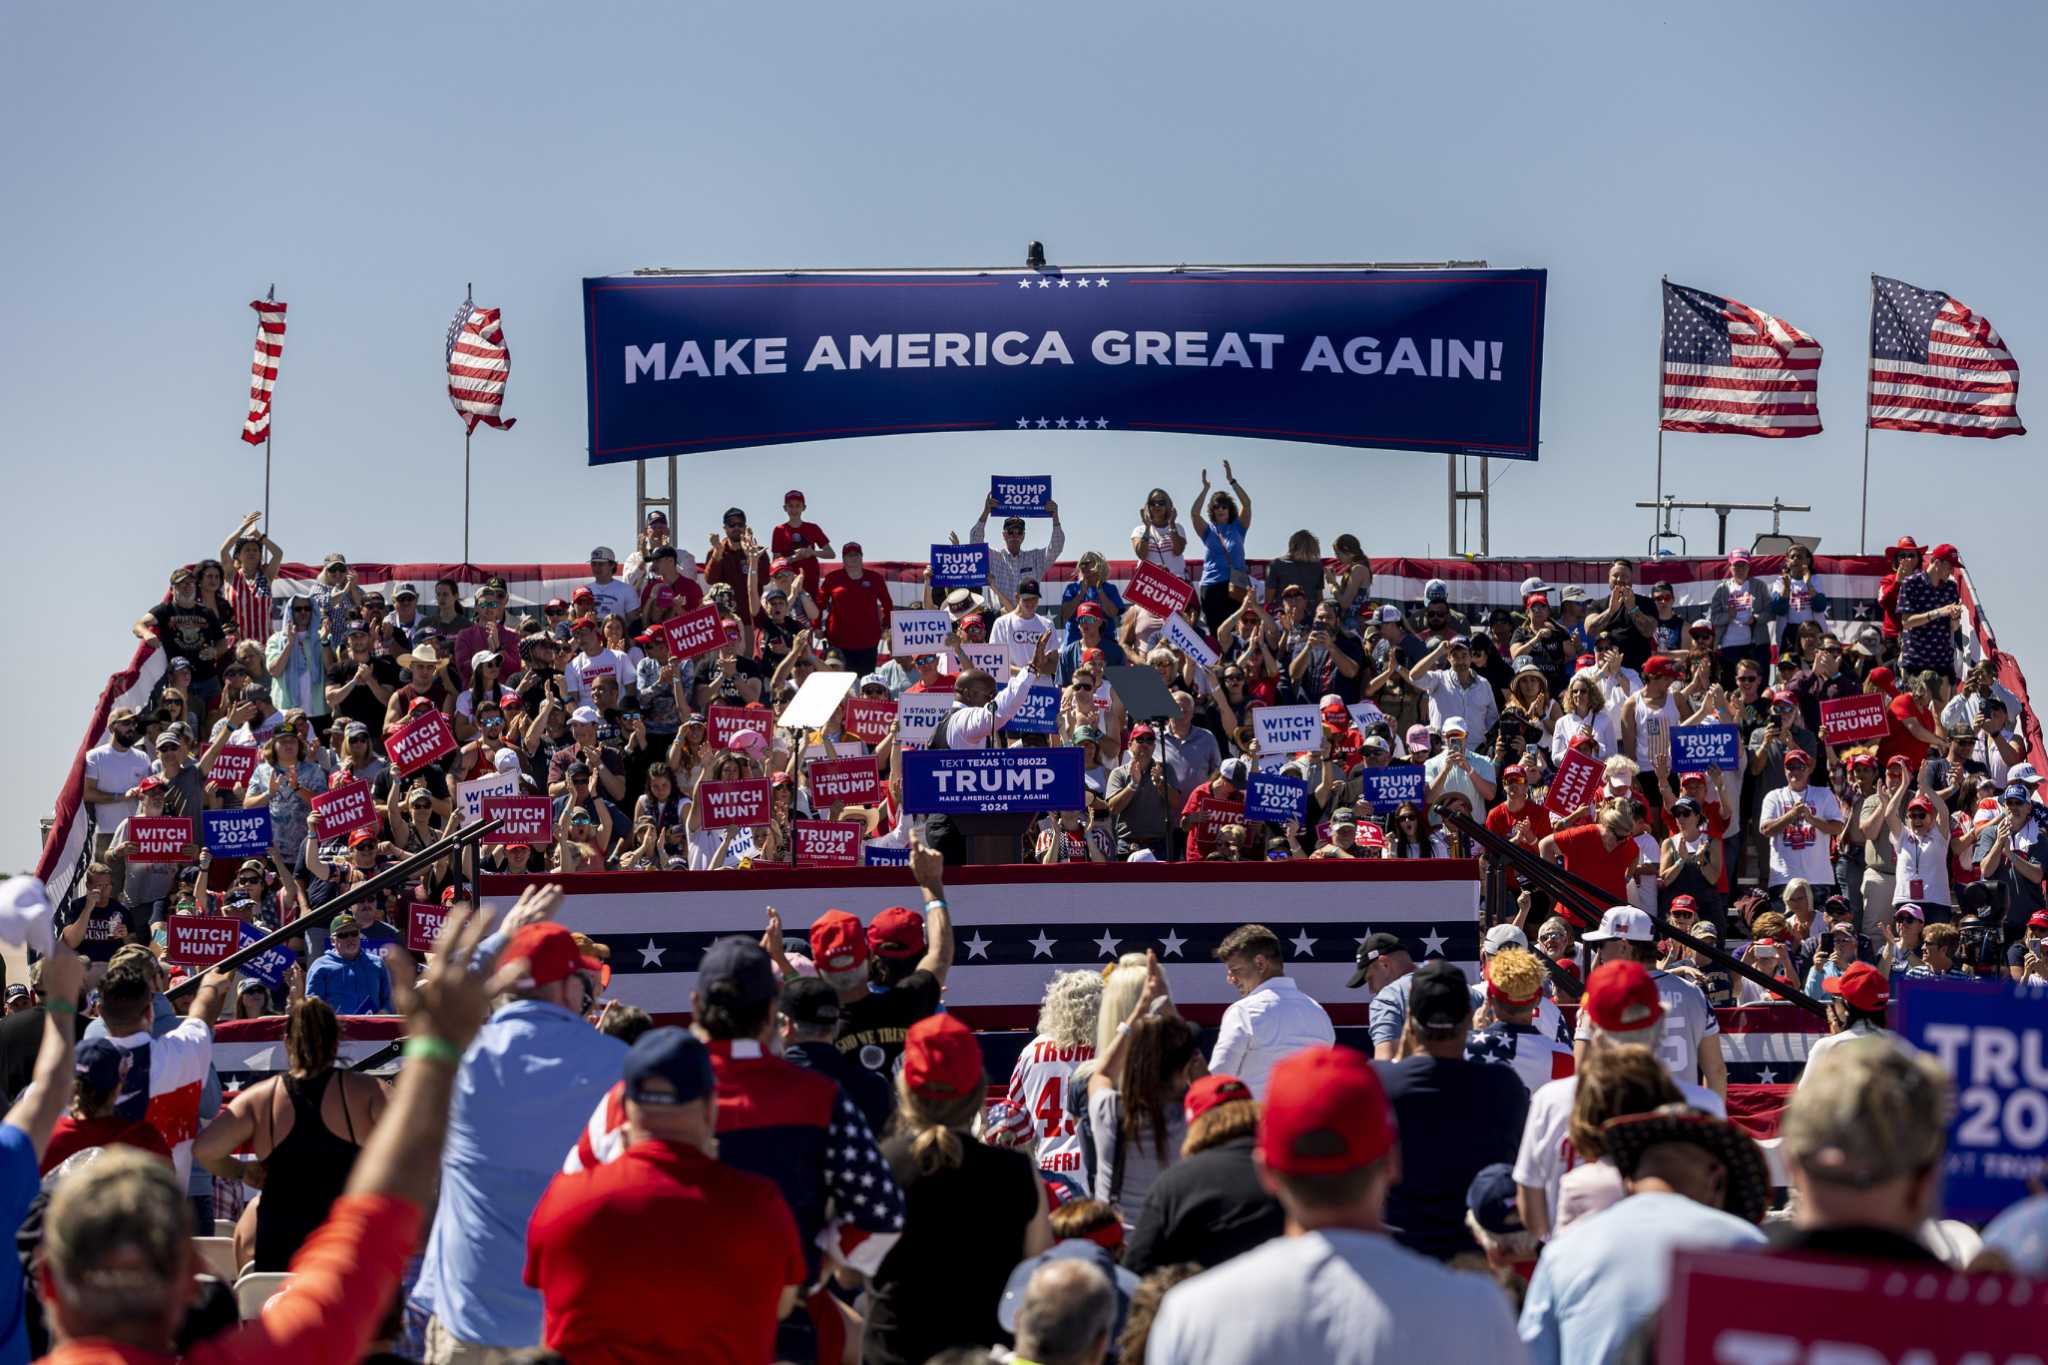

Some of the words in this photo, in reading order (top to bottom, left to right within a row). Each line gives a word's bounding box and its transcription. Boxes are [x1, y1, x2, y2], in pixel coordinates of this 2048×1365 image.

[625, 337, 787, 384] MAKE
[803, 330, 1074, 372] AMERICA
[1091, 330, 1285, 369] GREAT
[1300, 335, 1503, 381] AGAIN!
[997, 484, 1047, 495] TRUMP
[1004, 495, 1040, 505] 2024
[935, 552, 983, 564] TRUMP
[942, 563, 977, 574] 2024
[1134, 578, 1184, 612] TRUMP
[1144, 575, 1169, 594] STAND
[1169, 586, 1186, 603] WITH
[670, 616, 716, 640] WITCH
[899, 621, 946, 633] WITCH
[677, 629, 715, 651] HUNT
[904, 634, 944, 645] HUNT
[1171, 624, 1207, 666] WITCH
[1024, 695, 1055, 707] UMP
[853, 709, 897, 722] WITC
[1016, 706, 1045, 719] 024
[1830, 709, 1857, 720] STAND
[1859, 706, 1881, 715] WITH
[715, 716, 767, 732] WITCH
[903, 715, 941, 727] TRU
[1262, 717, 1315, 731] WITCH
[1826, 714, 1883, 733] TRUMP
[856, 723, 889, 736] HUN
[1268, 730, 1312, 743] HUNT
[393, 720, 441, 754] WITCH
[1677, 733, 1732, 747] TRUMP
[401, 735, 442, 764] HUNT
[1686, 745, 1725, 758] 2024
[940, 759, 964, 768] TEXT
[967, 758, 999, 767] TEXAS
[1001, 758, 1015, 766] TO
[1017, 757, 1048, 766] 88022
[208, 770, 245, 780] HUNT
[820, 772, 849, 782] STAND
[850, 771, 874, 780] WITH
[932, 768, 1056, 793] TRUMP
[1370, 774, 1421, 787] TRUMP
[816, 779, 875, 796] TRUMP
[1556, 762, 1580, 804] HUNT
[1565, 765, 1594, 813] WITCH
[465, 783, 514, 802] WITCH
[708, 790, 763, 805] WITCH
[1254, 782, 1304, 799] TRUMP
[1378, 786, 1416, 799] 2024
[319, 791, 366, 817] WITCH
[980, 803, 1009, 812] 2024
[1260, 795, 1298, 810] 2024
[325, 806, 364, 829] HUNT
[490, 808, 545, 820] WITCH
[713, 804, 759, 819] HUNT
[1207, 809, 1246, 824] WITC
[209, 817, 265, 832] TRUMP
[496, 822, 541, 834] HUNT
[136, 827, 187, 840] WITCH
[218, 830, 258, 843] 2024
[797, 828, 854, 841] TRUMP
[140, 842, 183, 853] HUNT
[727, 840, 753, 857] HUN
[804, 841, 846, 854] 2024
[416, 912, 449, 927] TRU
[176, 927, 232, 942] WITCH
[422, 927, 445, 938] 20
[180, 942, 227, 955] HUNT
[240, 931, 287, 967] TRMP
[857, 1029, 875, 1044] WE
[1034, 1040, 1095, 1063] TRUM
